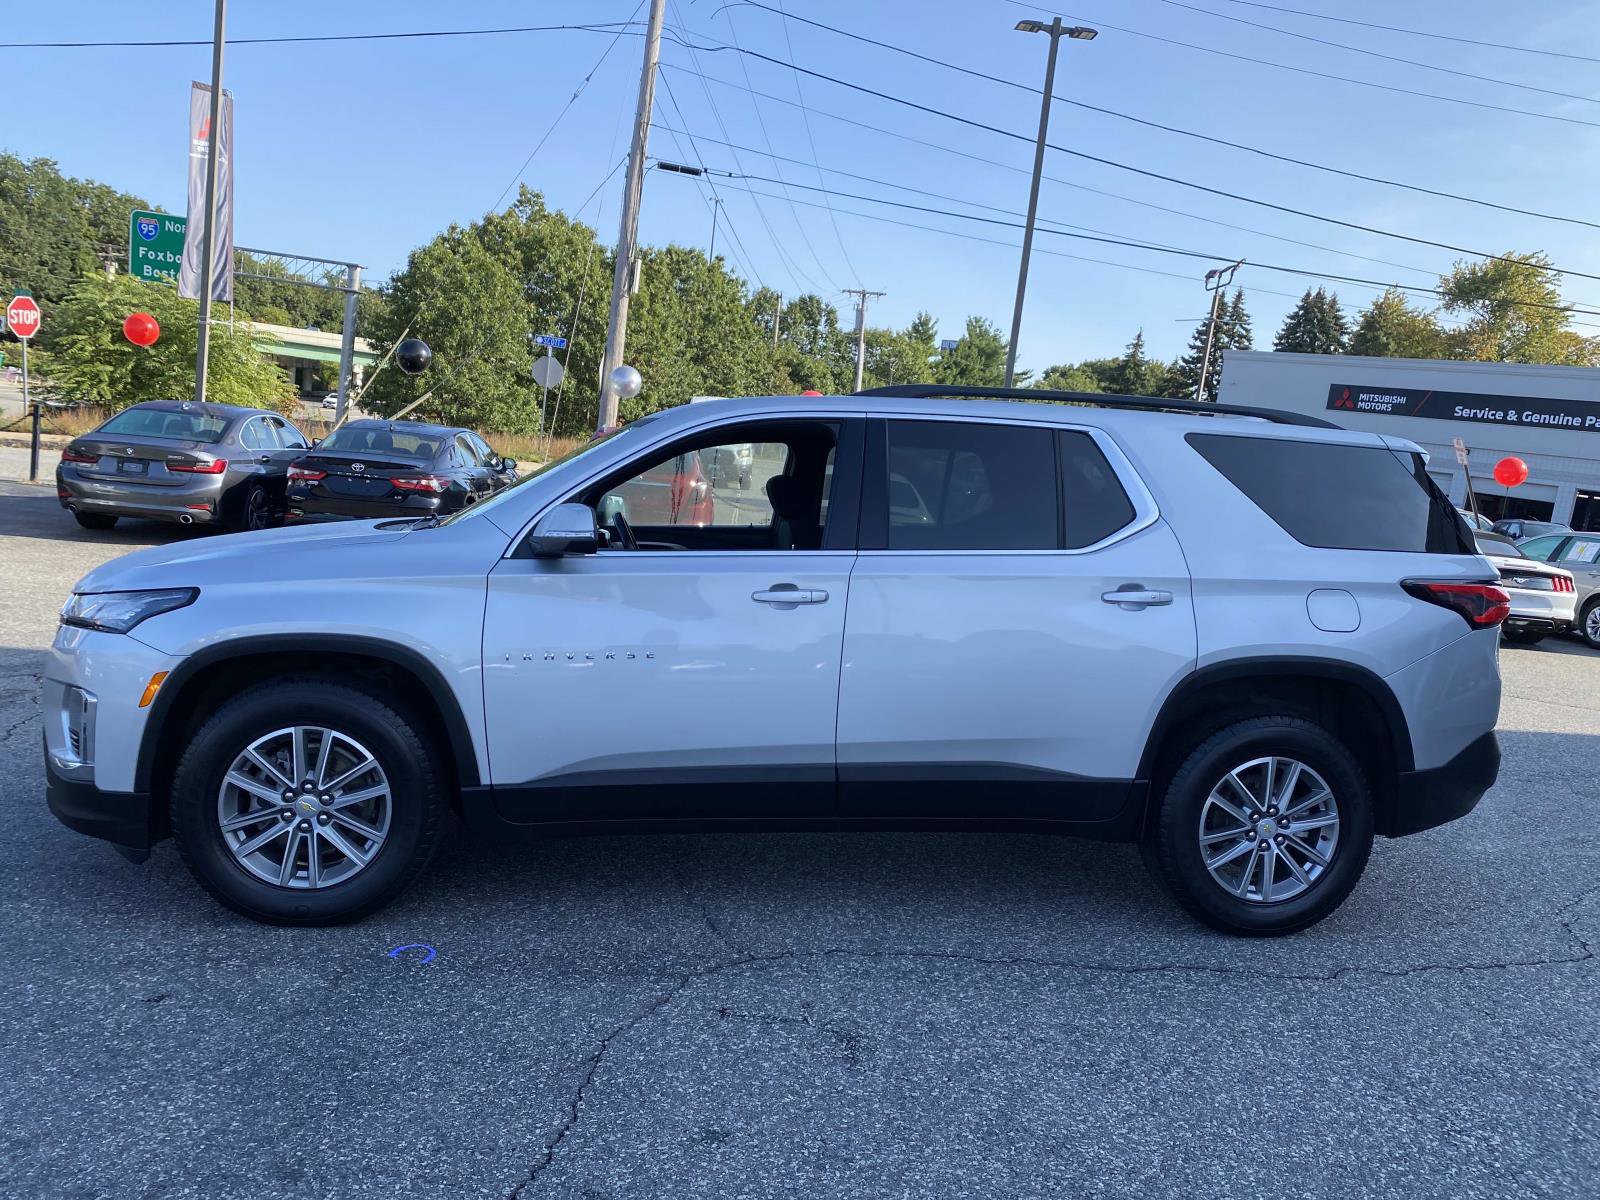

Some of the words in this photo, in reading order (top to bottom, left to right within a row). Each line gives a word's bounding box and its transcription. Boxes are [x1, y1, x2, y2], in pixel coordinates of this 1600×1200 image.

[141, 223, 156, 236] 95
[10, 309, 38, 325] STOP
[1359, 393, 1407, 404] MITSUBISHI
[1357, 401, 1393, 411] MOTORS
[1454, 405, 1504, 420] Service
[1506, 410, 1518, 421] &
[1522, 411, 1582, 426] Genuine
